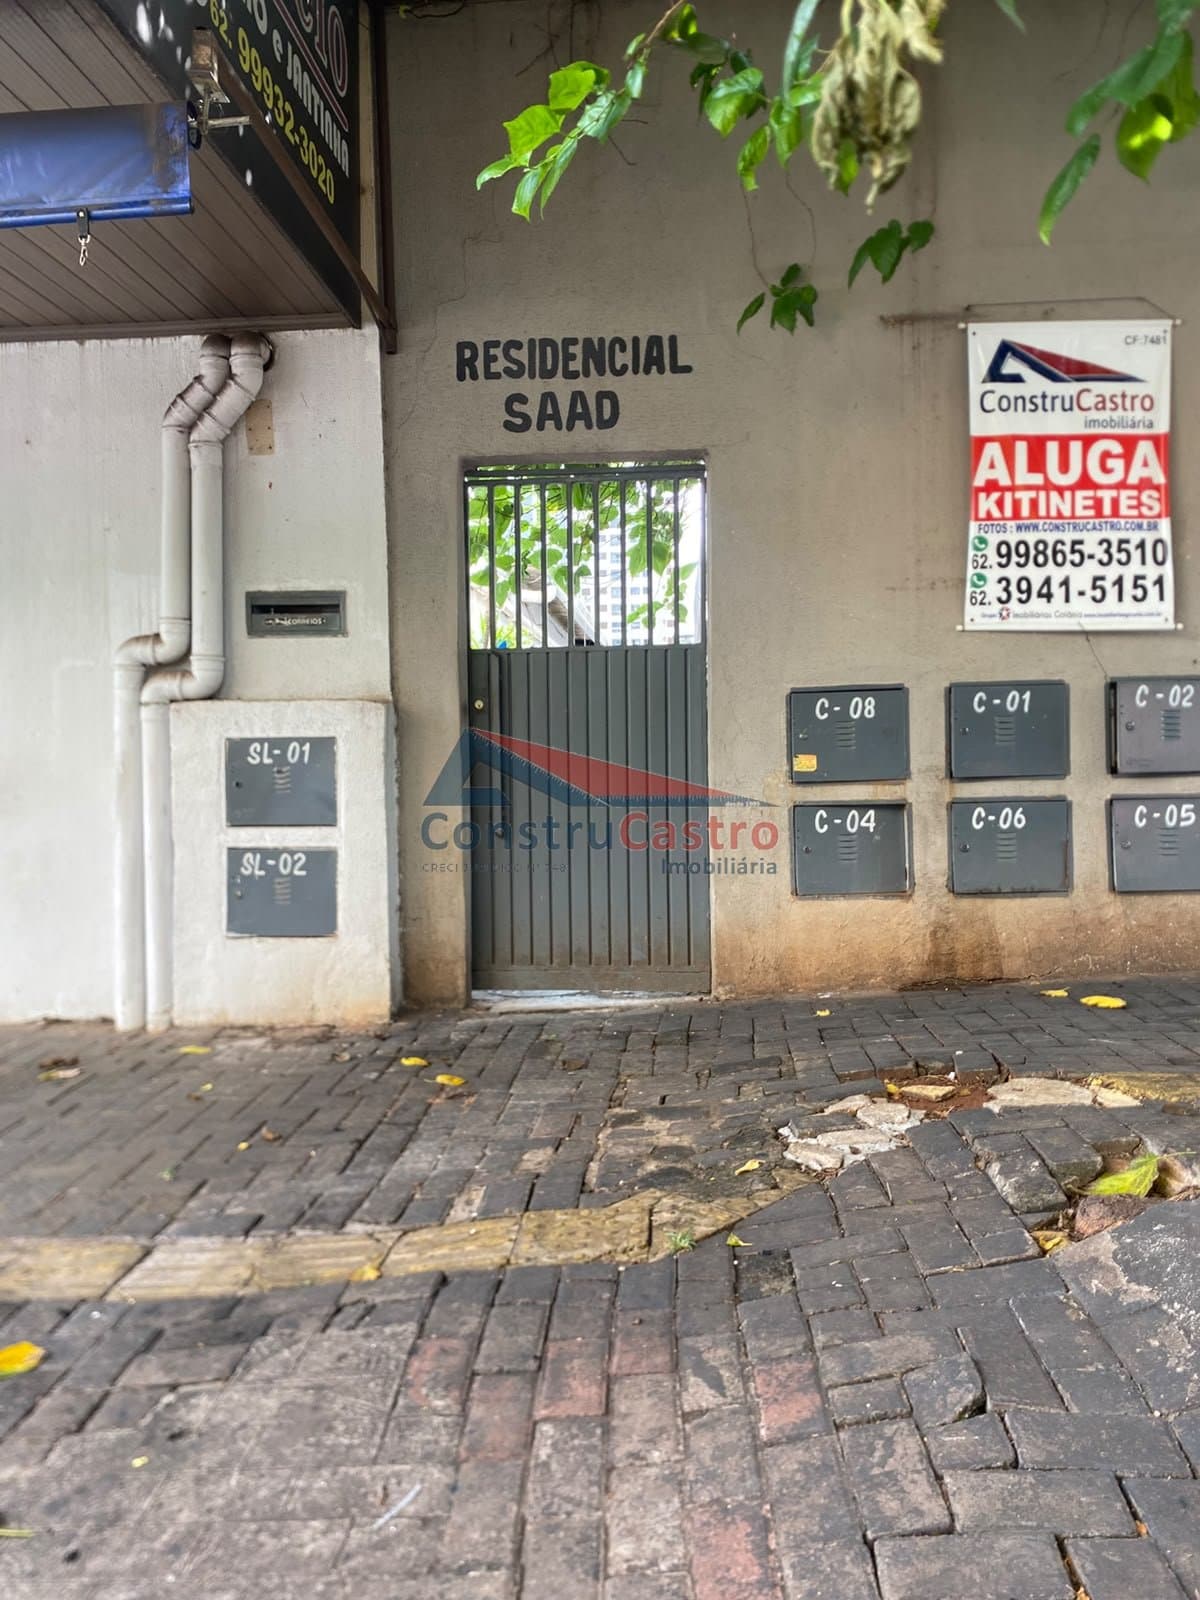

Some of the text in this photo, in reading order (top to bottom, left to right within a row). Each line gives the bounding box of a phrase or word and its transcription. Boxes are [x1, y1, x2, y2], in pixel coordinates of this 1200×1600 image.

[456, 334, 693, 382] RESIDENCIAL
[503, 390, 620, 433] SAAD
[980, 389, 1155, 414] ConstruCastro
[1084, 415, 1154, 430] imobiliária
[973, 439, 1167, 487] ALUGA
[977, 488, 1162, 519] KITINETES
[996, 538, 1168, 568] 99865-3510
[996, 574, 1165, 605] 3941-5151
